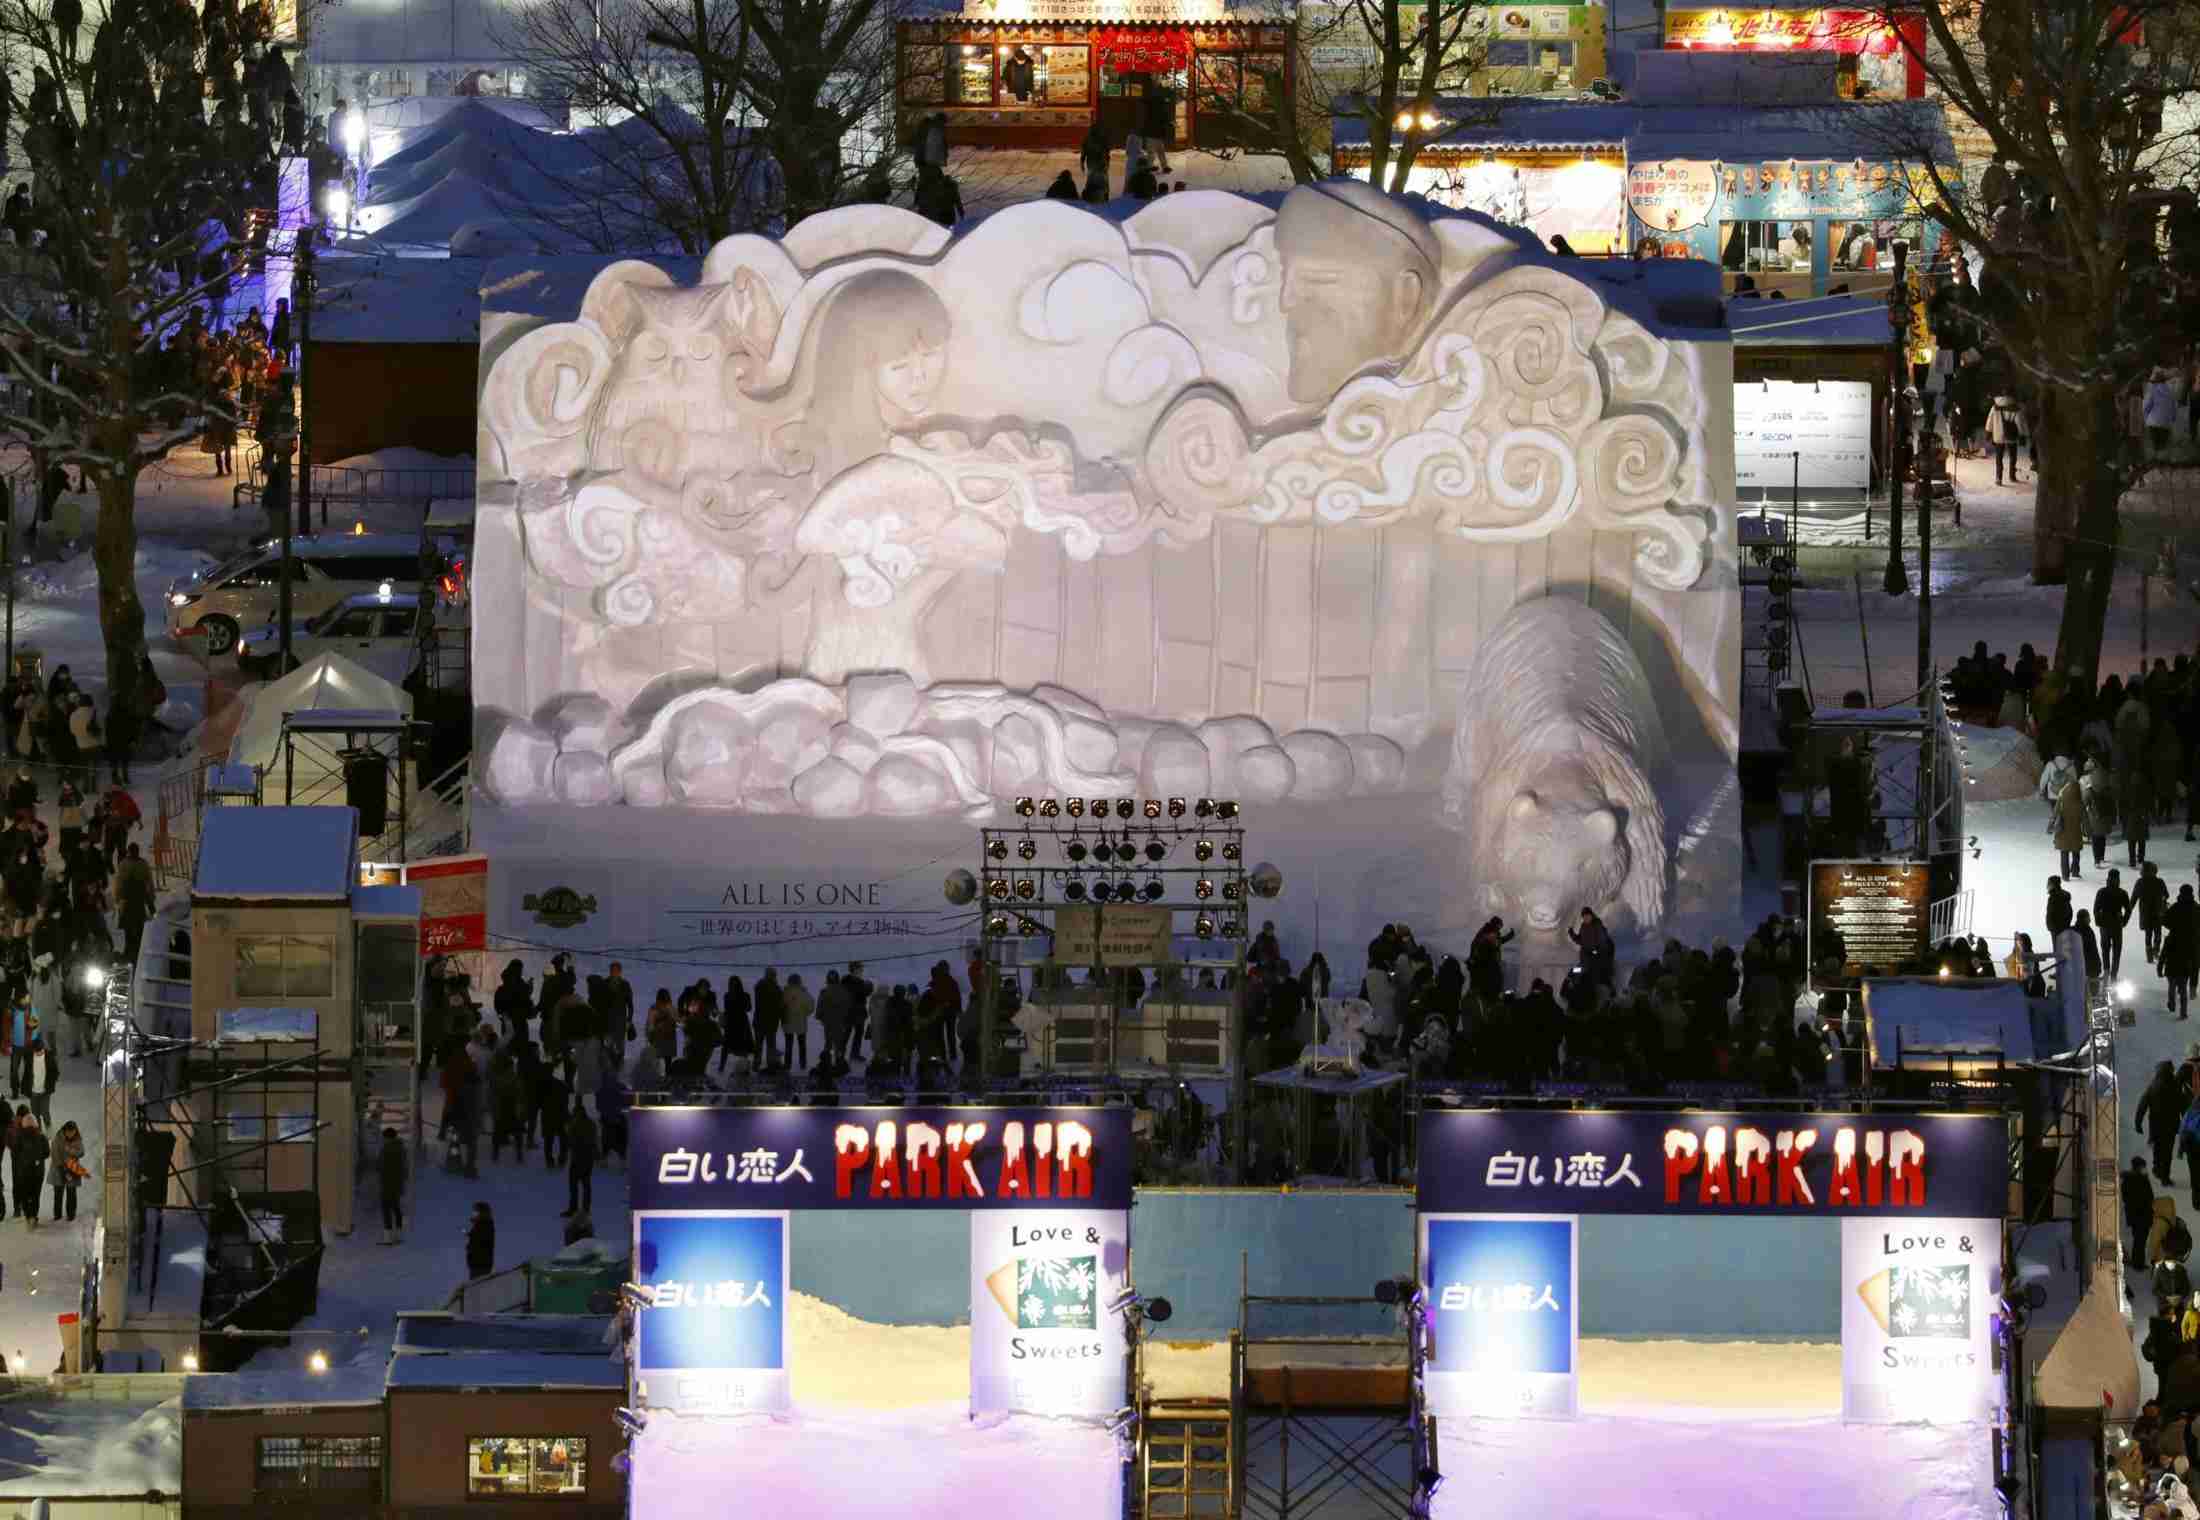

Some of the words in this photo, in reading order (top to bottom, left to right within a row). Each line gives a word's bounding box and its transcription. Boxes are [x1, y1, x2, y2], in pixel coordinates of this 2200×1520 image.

[721, 883, 770, 905] ALL
[783, 883, 805, 905] IS
[816, 883, 881, 905] ONE
[658, 1147, 814, 1184] 白い恋人
[834, 1120, 987, 1198] PARK
[997, 1120, 1095, 1198] AIR
[1485, 1150, 1642, 1187] 白い恋人
[1663, 1126, 1818, 1206] PARK
[1828, 1126, 1927, 1207] AIR
[1012, 1225, 1073, 1247] Love
[1085, 1226, 1101, 1244] &
[1883, 1233, 1946, 1255] Love
[1958, 1235, 1974, 1253] &
[1011, 1338, 1102, 1360] Sweets
[1883, 1346, 1976, 1368] Swts
